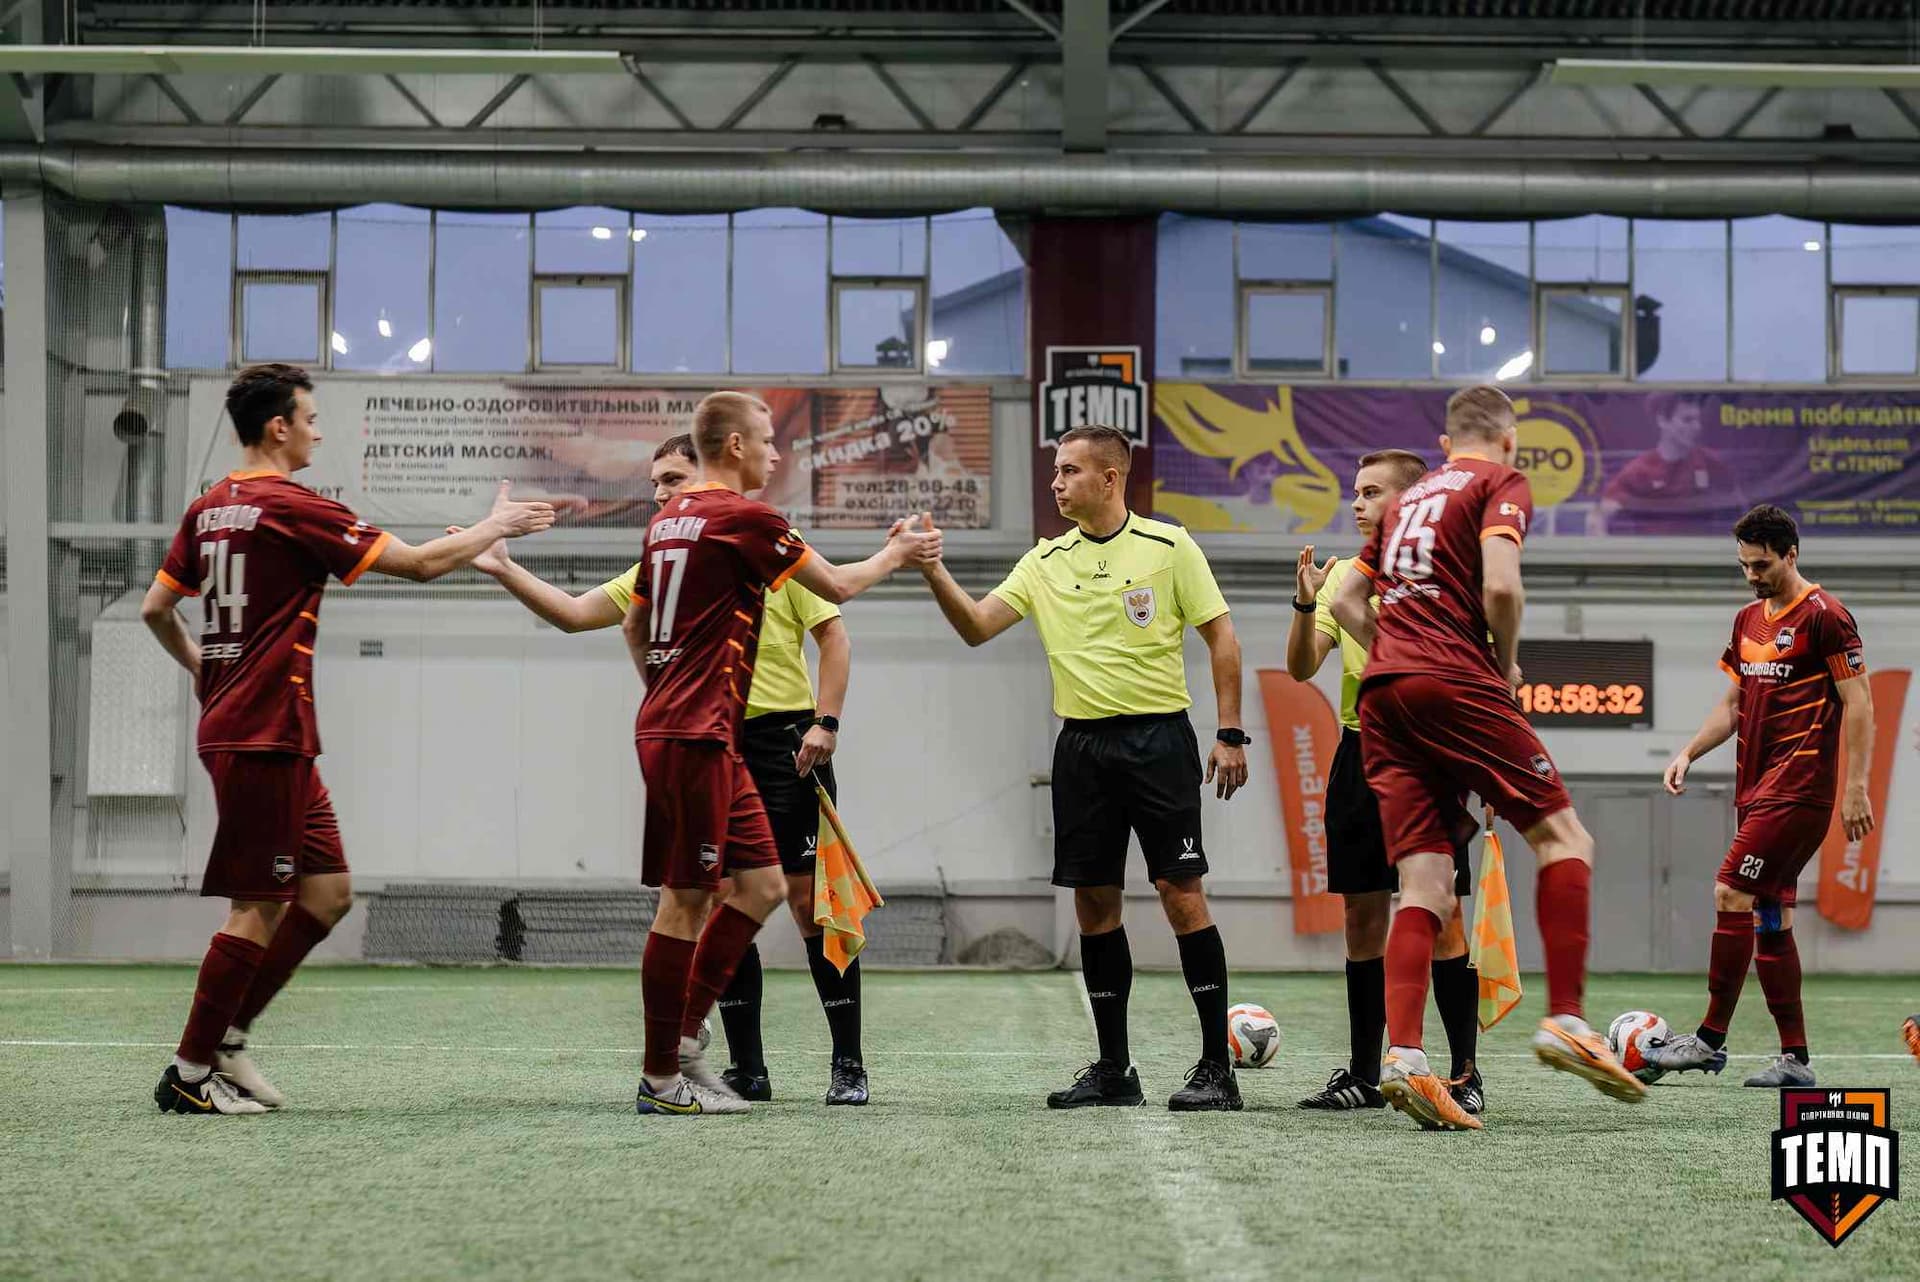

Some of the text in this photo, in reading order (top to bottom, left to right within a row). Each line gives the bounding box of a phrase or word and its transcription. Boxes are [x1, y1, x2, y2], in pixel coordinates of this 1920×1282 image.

[365, 397, 660, 414] ЛЕЧЕБНО-ОЗДОРОВИТЕЛЬНЫЙ
[1050, 385, 1137, 432] ТЕМП
[1720, 405, 1794, 429] Время
[364, 442, 454, 459] ДЕТСКИЙ
[650, 548, 689, 642] 17
[1518, 683, 1644, 714] 18:58:32
[1738, 854, 1764, 880] 23
